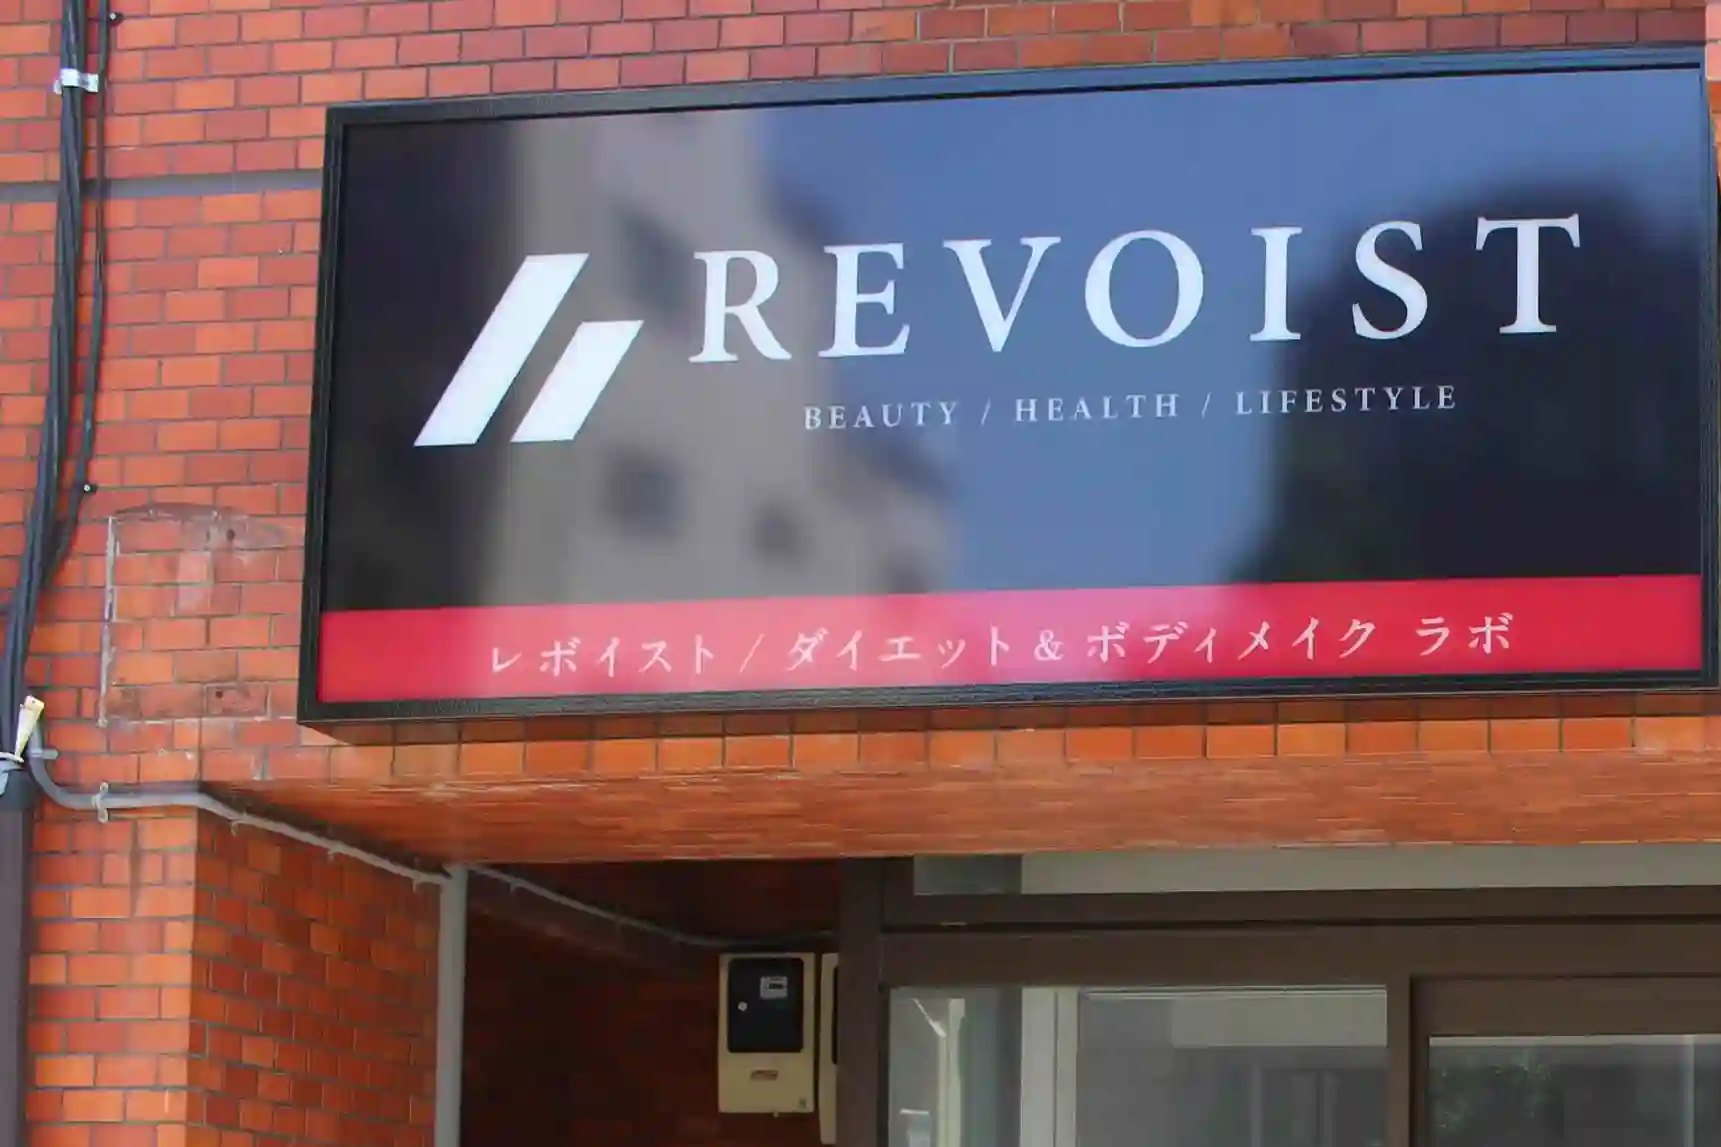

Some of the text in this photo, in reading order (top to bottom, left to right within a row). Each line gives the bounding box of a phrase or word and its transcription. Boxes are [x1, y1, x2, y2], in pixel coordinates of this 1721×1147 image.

[688, 212, 1581, 363] REVOIST
[804, 401, 958, 430] BEAUTY
[1015, 394, 1180, 421] HEALTH
[1235, 385, 1456, 415] LIFESTYLE
[492, 634, 714, 677] レボイスト
[787, 626, 1010, 672] ダイエット
[1034, 629, 1065, 662] &
[1087, 616, 1376, 664] ボディメイク
[1415, 612, 1513, 657] ラボ
